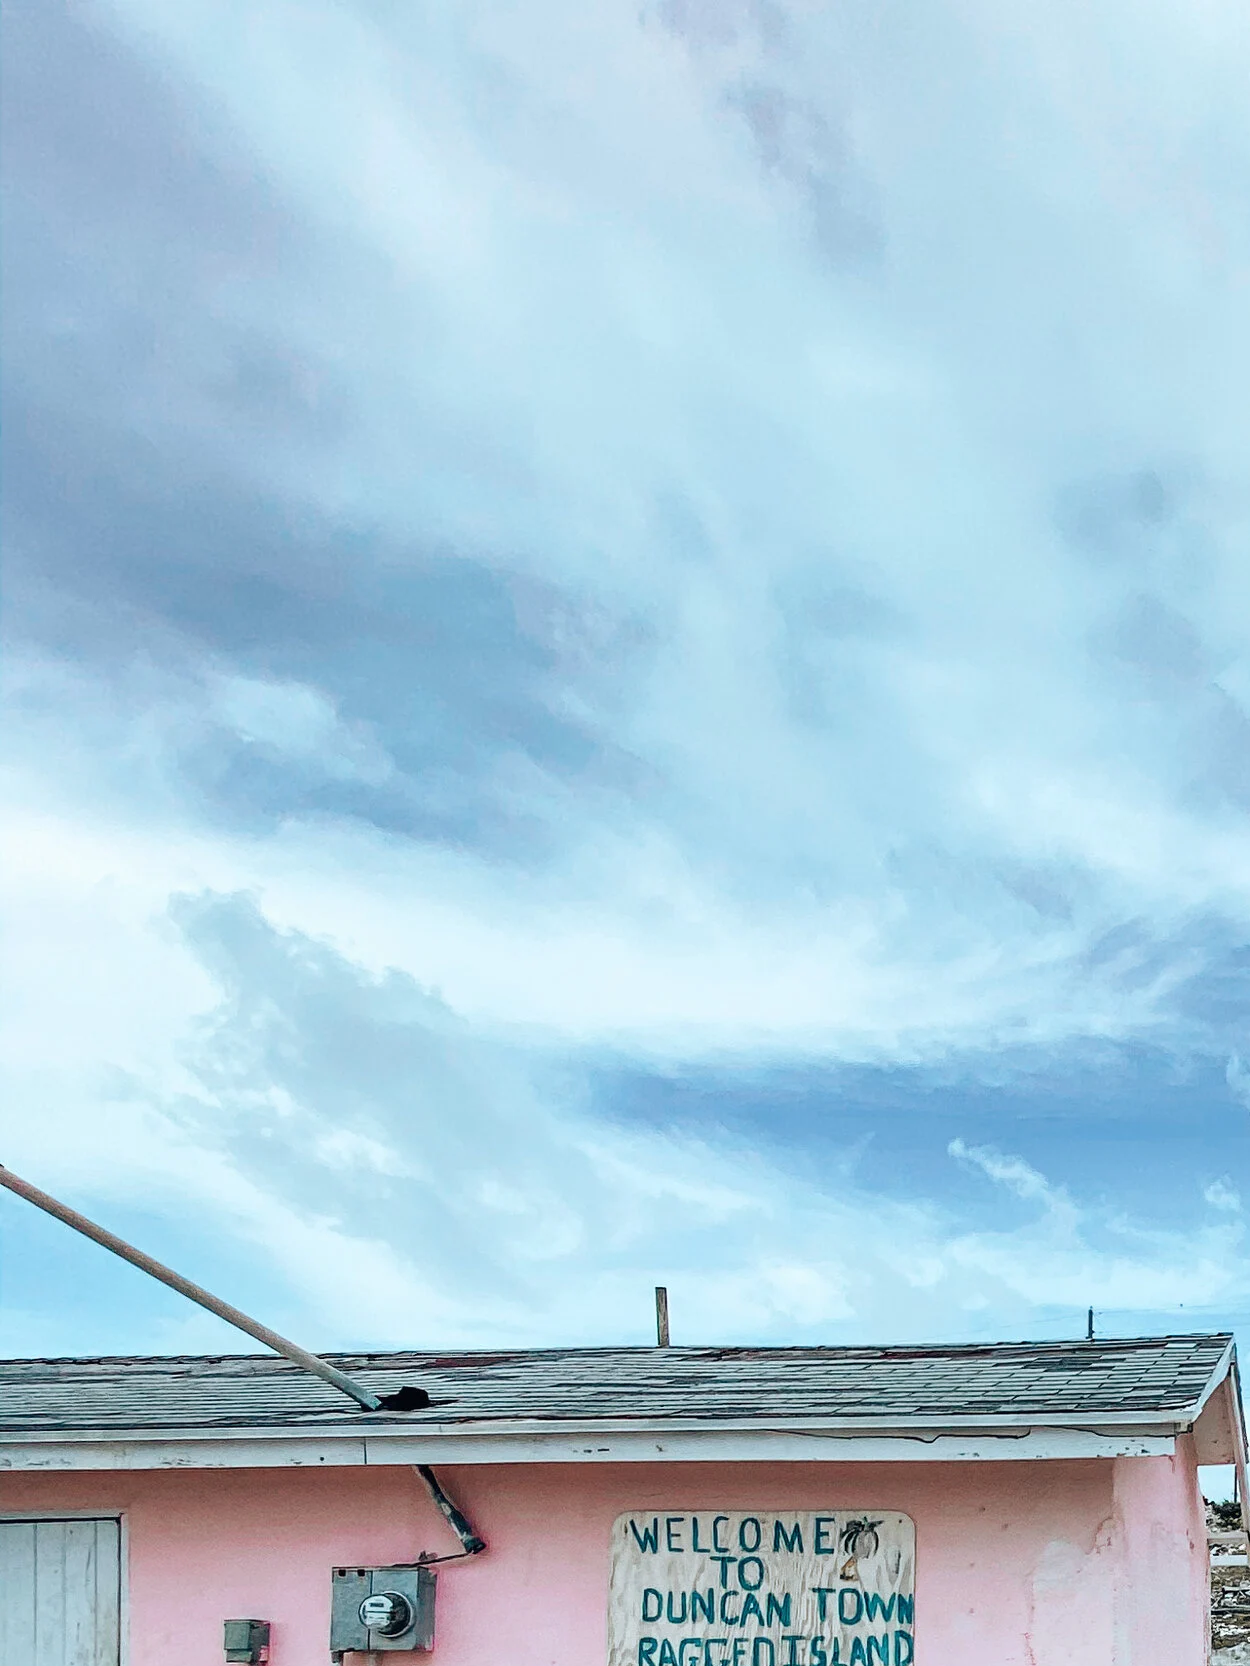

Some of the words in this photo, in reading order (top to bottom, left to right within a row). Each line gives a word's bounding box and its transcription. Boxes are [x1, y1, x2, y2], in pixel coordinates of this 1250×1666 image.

[630, 1516, 835, 1554] WELCOME
[710, 1556, 764, 1591] TO
[642, 1588, 791, 1627] DUNCAN
[812, 1587, 913, 1625] TOWN
